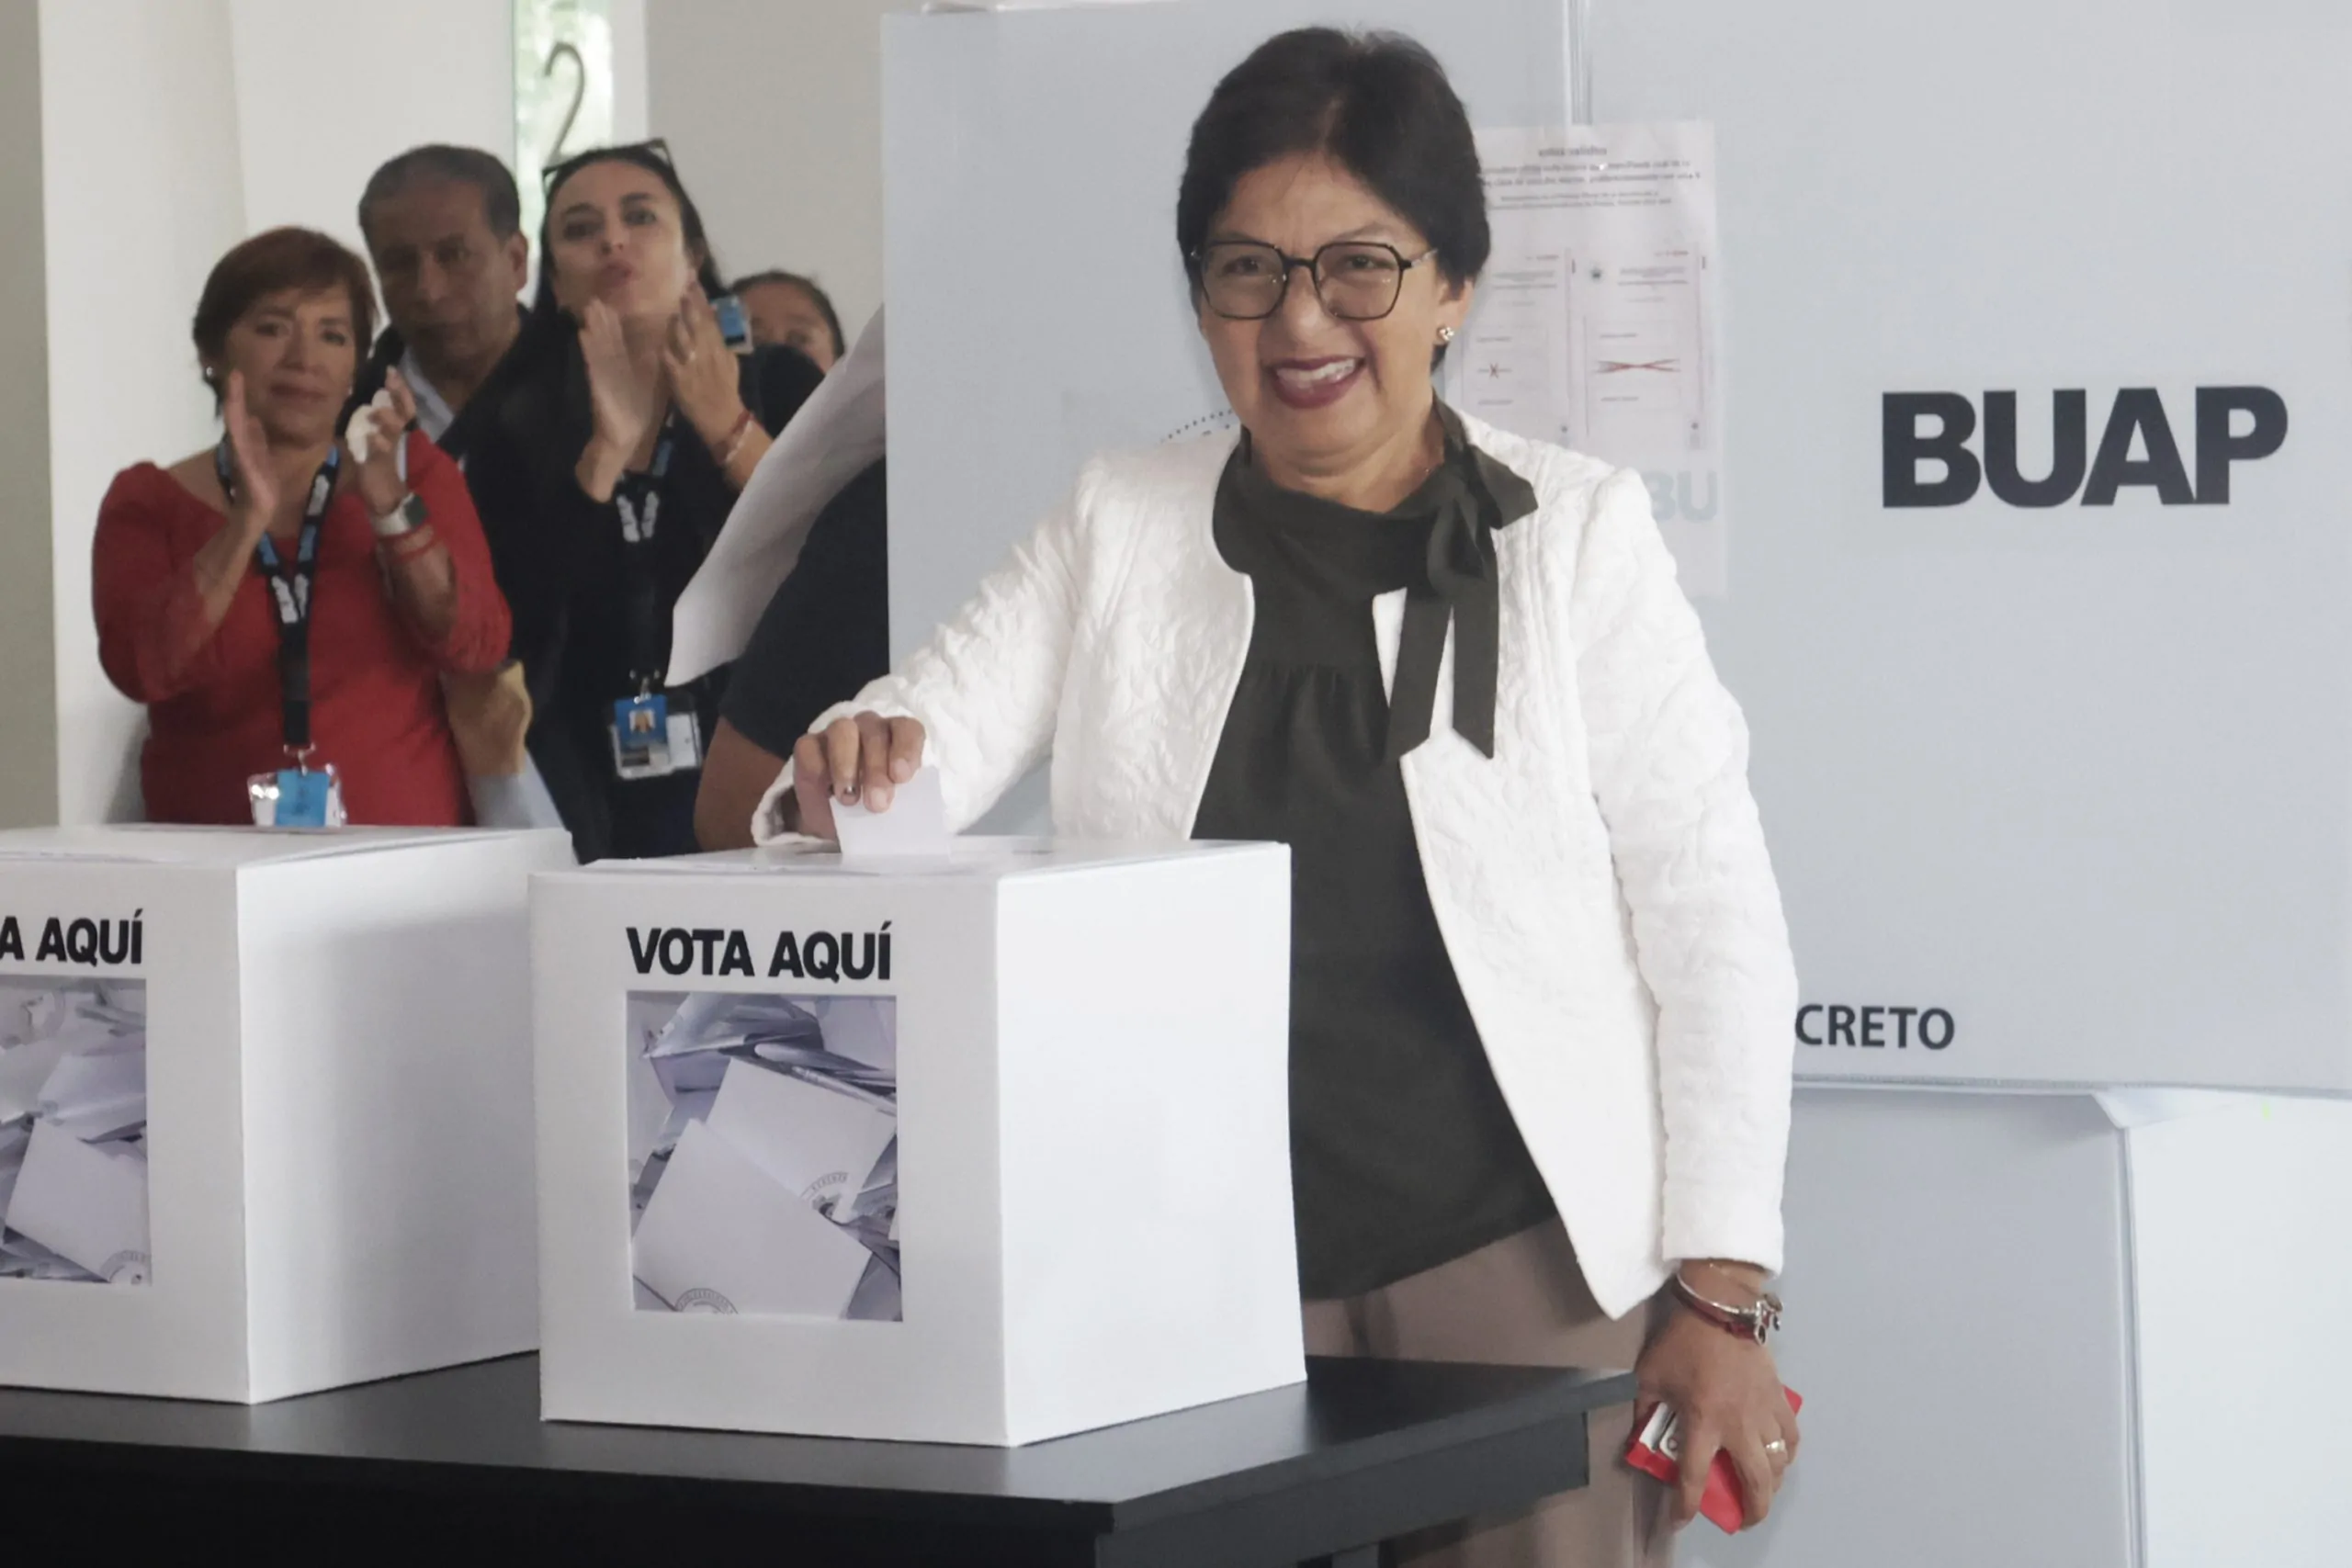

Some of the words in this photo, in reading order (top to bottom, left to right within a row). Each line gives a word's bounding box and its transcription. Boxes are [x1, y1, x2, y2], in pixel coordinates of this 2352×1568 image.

[1882, 385, 2289, 509] BUAP
[36, 908, 142, 967] AQUÍ
[626, 927, 755, 977] VOTA
[767, 920, 892, 984] AQUÍ
[1794, 1003, 1956, 1051] CRETO
